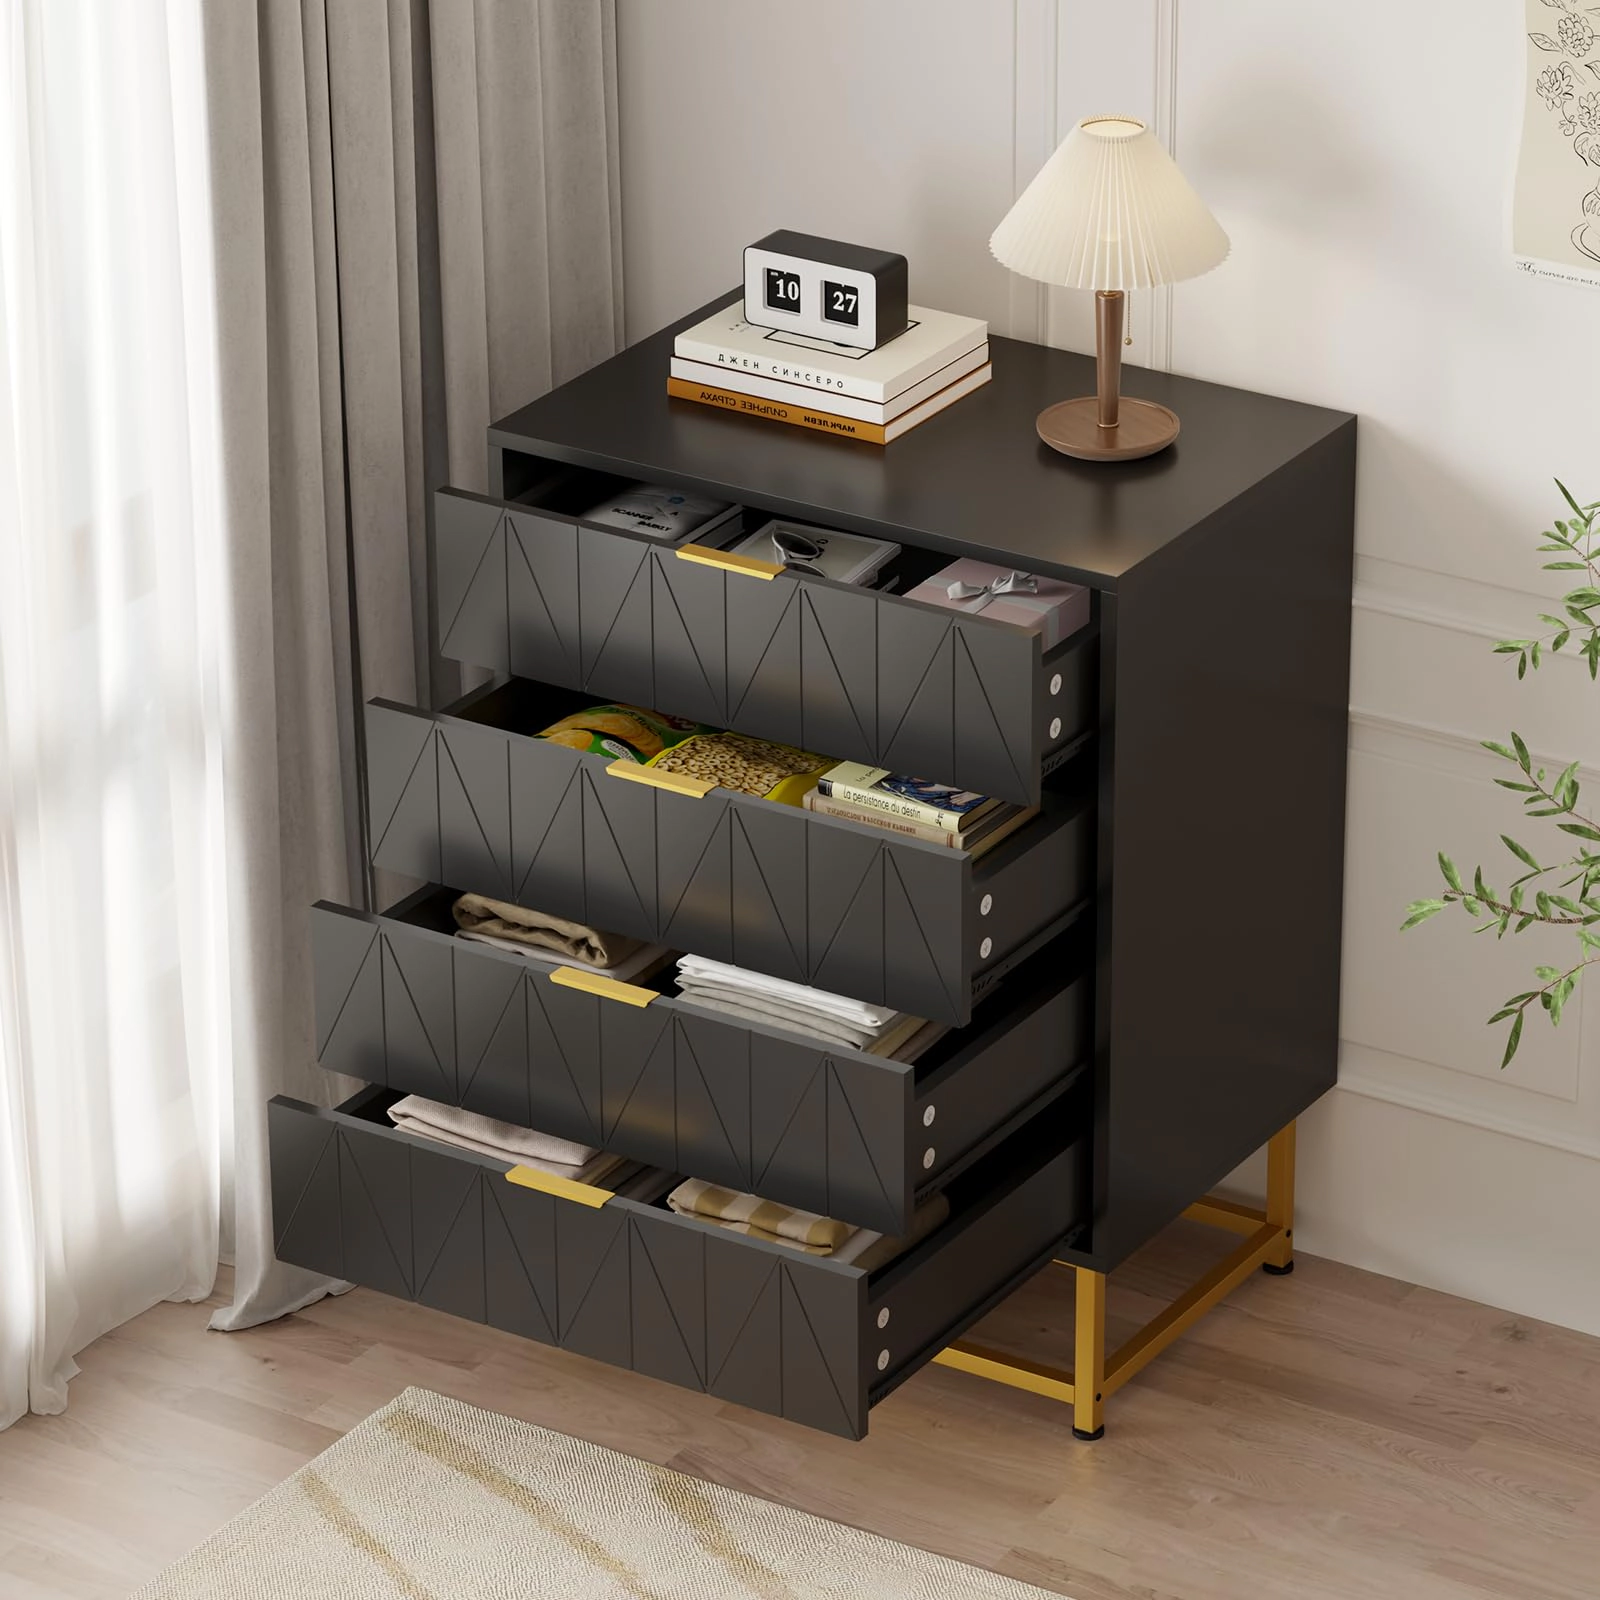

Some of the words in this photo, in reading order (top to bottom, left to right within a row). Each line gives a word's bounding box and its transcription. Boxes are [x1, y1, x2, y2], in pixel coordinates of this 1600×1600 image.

[1515, 261, 1537, 277] My
[776, 278, 799, 301] 10
[832, 290, 858, 314] 27
[718, 353, 760, 369] ДЖЕН
[772, 366, 844, 388] СИНСЕРО
[843, 786, 852, 800] La
[852, 792, 890, 811] persistance
[890, 800, 900, 815] du
[901, 801, 921, 821] destin
